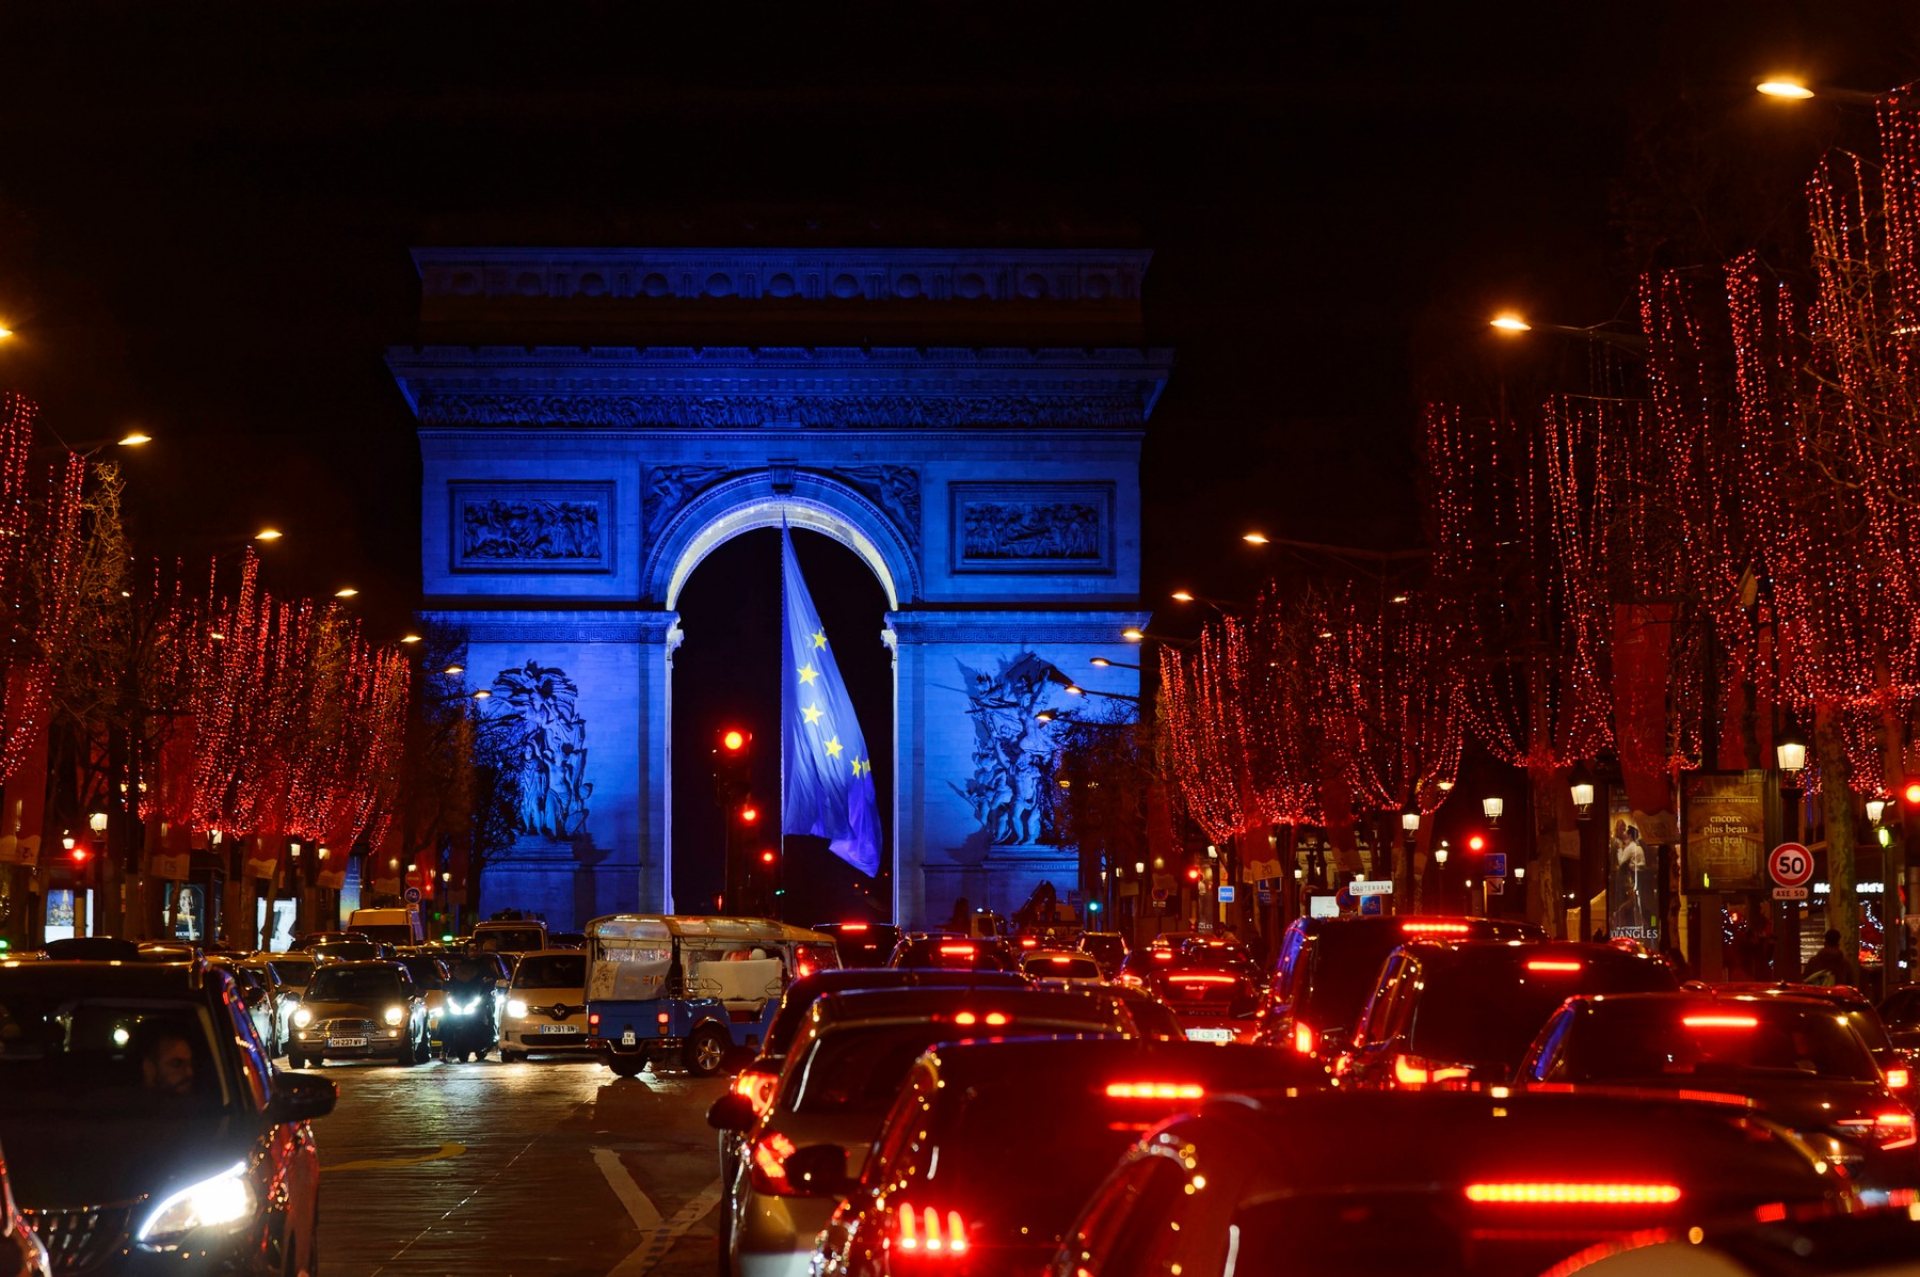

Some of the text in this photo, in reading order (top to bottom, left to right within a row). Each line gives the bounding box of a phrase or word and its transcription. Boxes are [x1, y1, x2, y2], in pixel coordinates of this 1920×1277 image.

[1709, 815, 1742, 823] encore
[1703, 824, 1748, 836] plus beau
[1709, 835, 1743, 845] en vrai
[1779, 856, 1804, 874] 50
